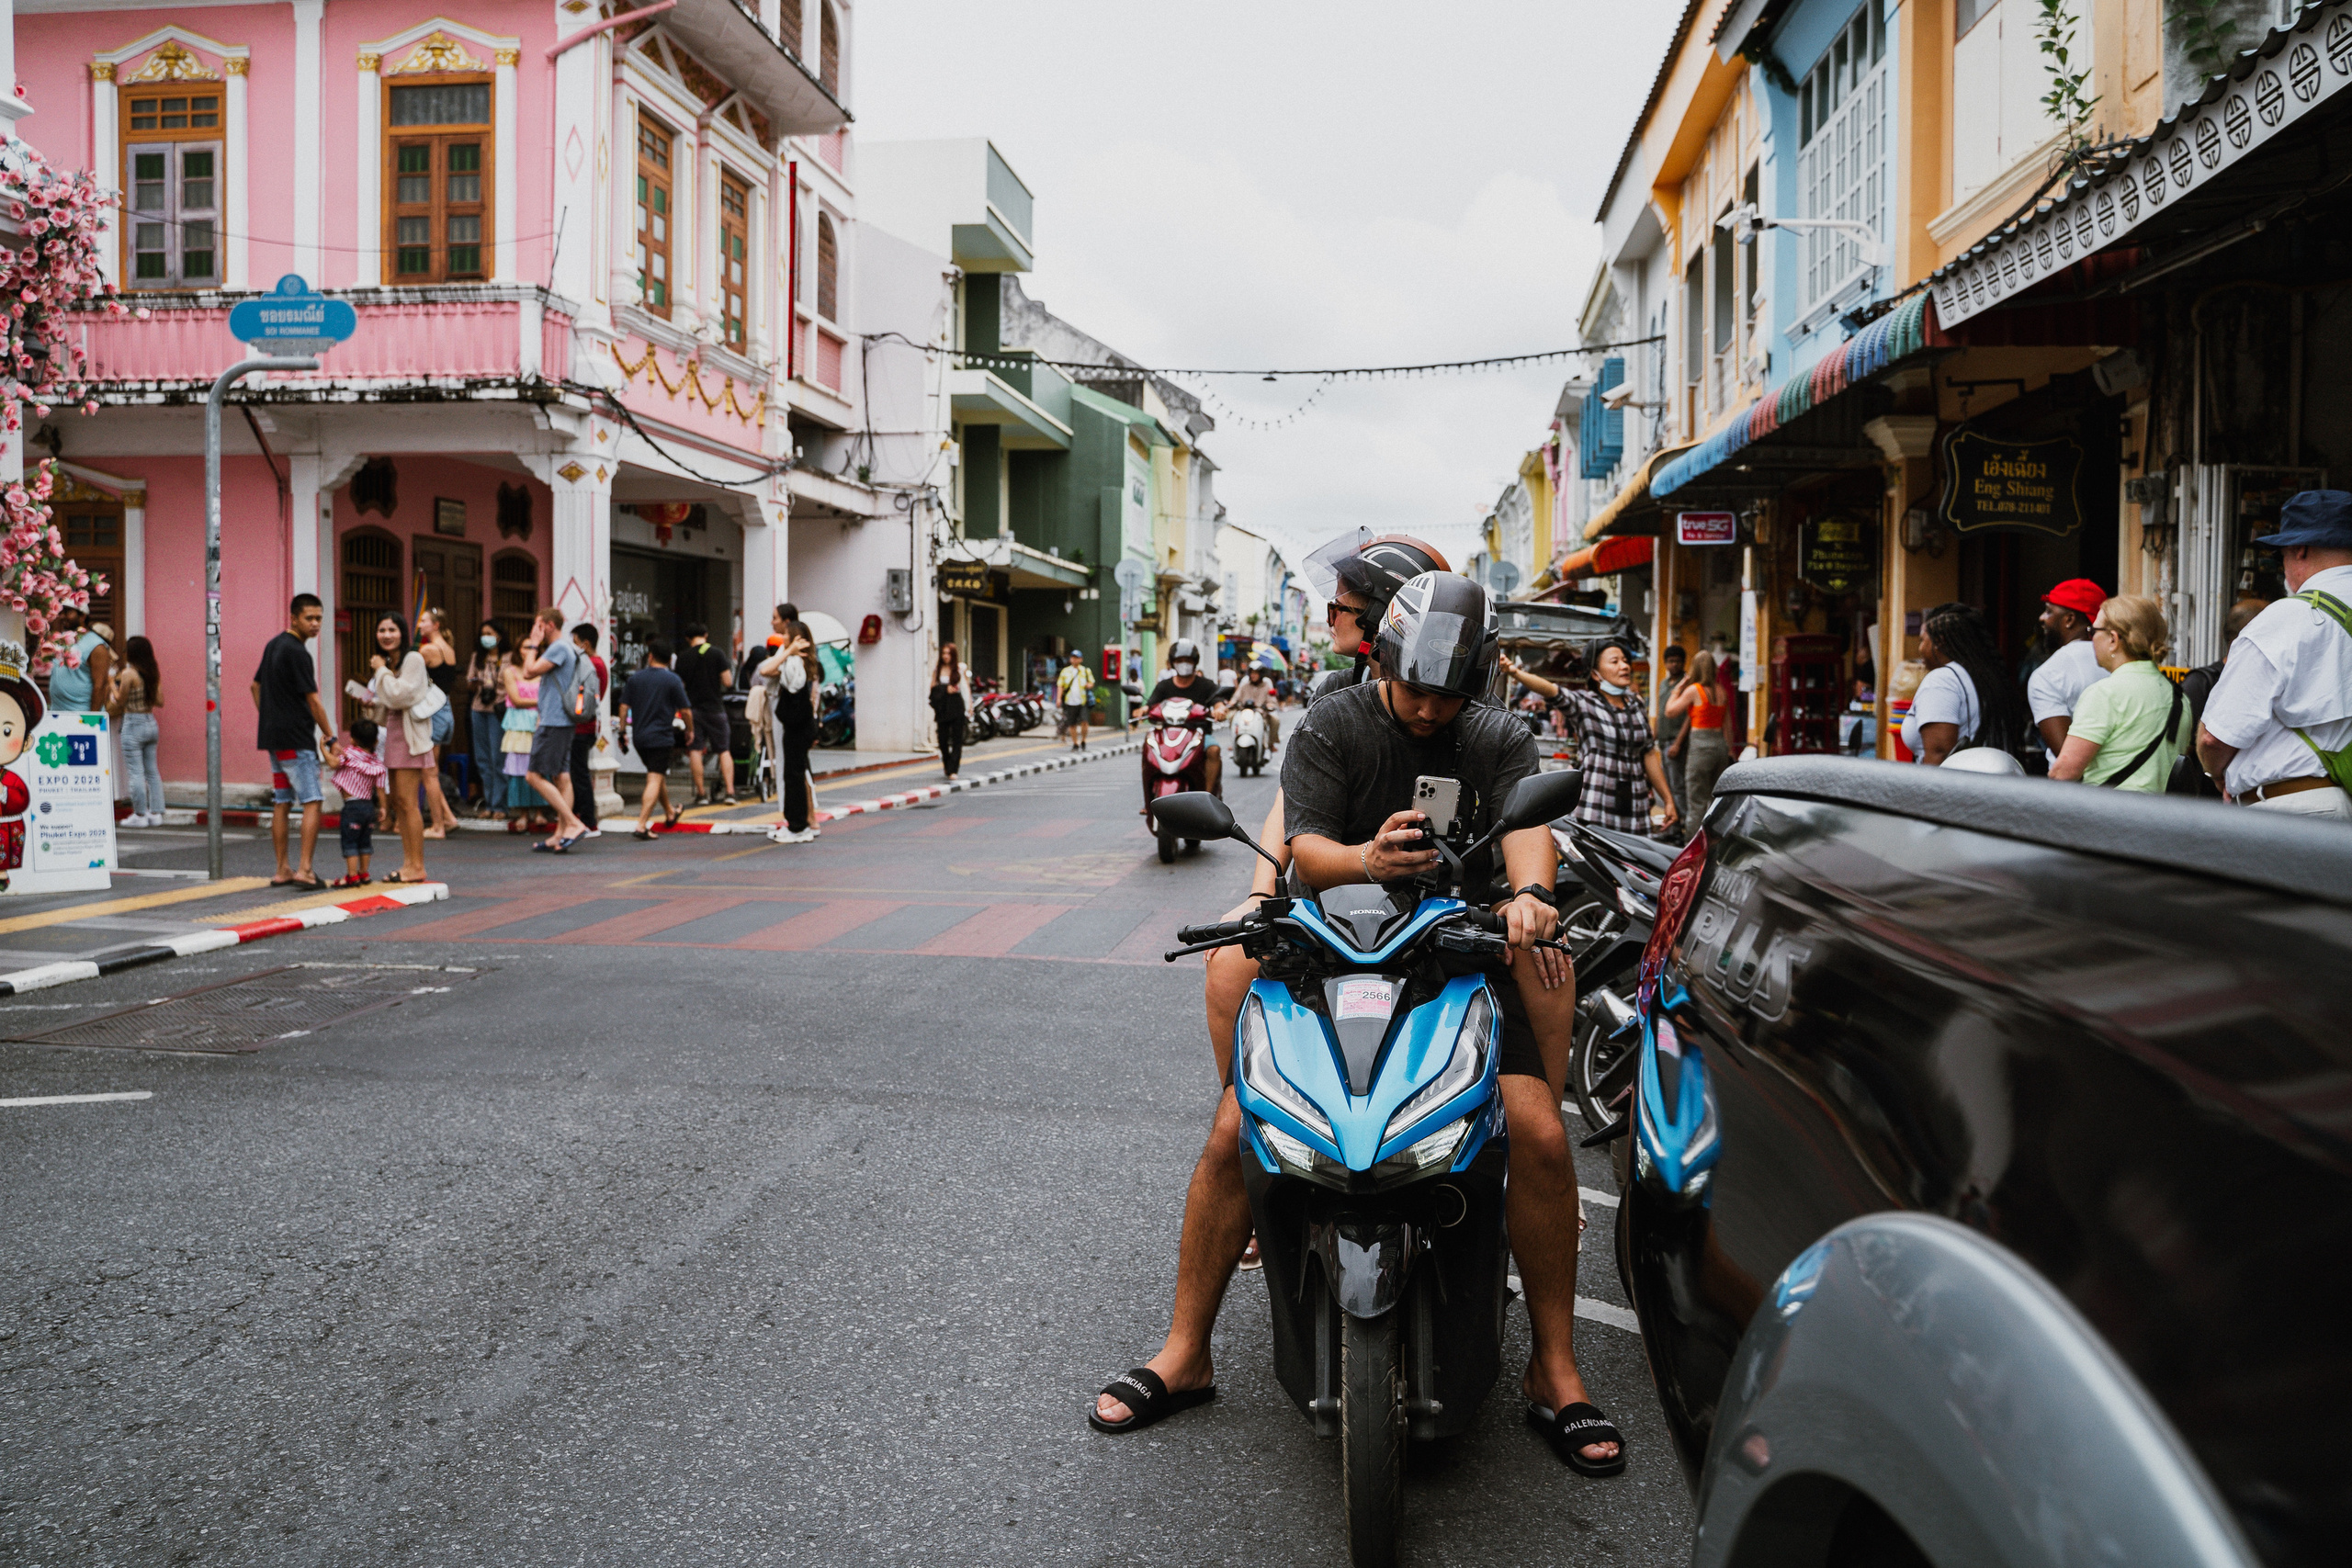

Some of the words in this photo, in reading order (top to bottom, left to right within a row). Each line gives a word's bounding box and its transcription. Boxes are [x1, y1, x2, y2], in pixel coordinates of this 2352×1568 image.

[265, 326, 277, 336] SOI
[1974, 478, 2002, 500] Eng
[2007, 479, 2054, 502] Shiang
[39, 774, 69, 785] EXPO
[74, 774, 101, 785] 2028
[40, 830, 67, 839] Phuket
[69, 830, 87, 839] Expo
[1678, 895, 1814, 1023] PLUS
[1362, 990, 1391, 1001] 2566
